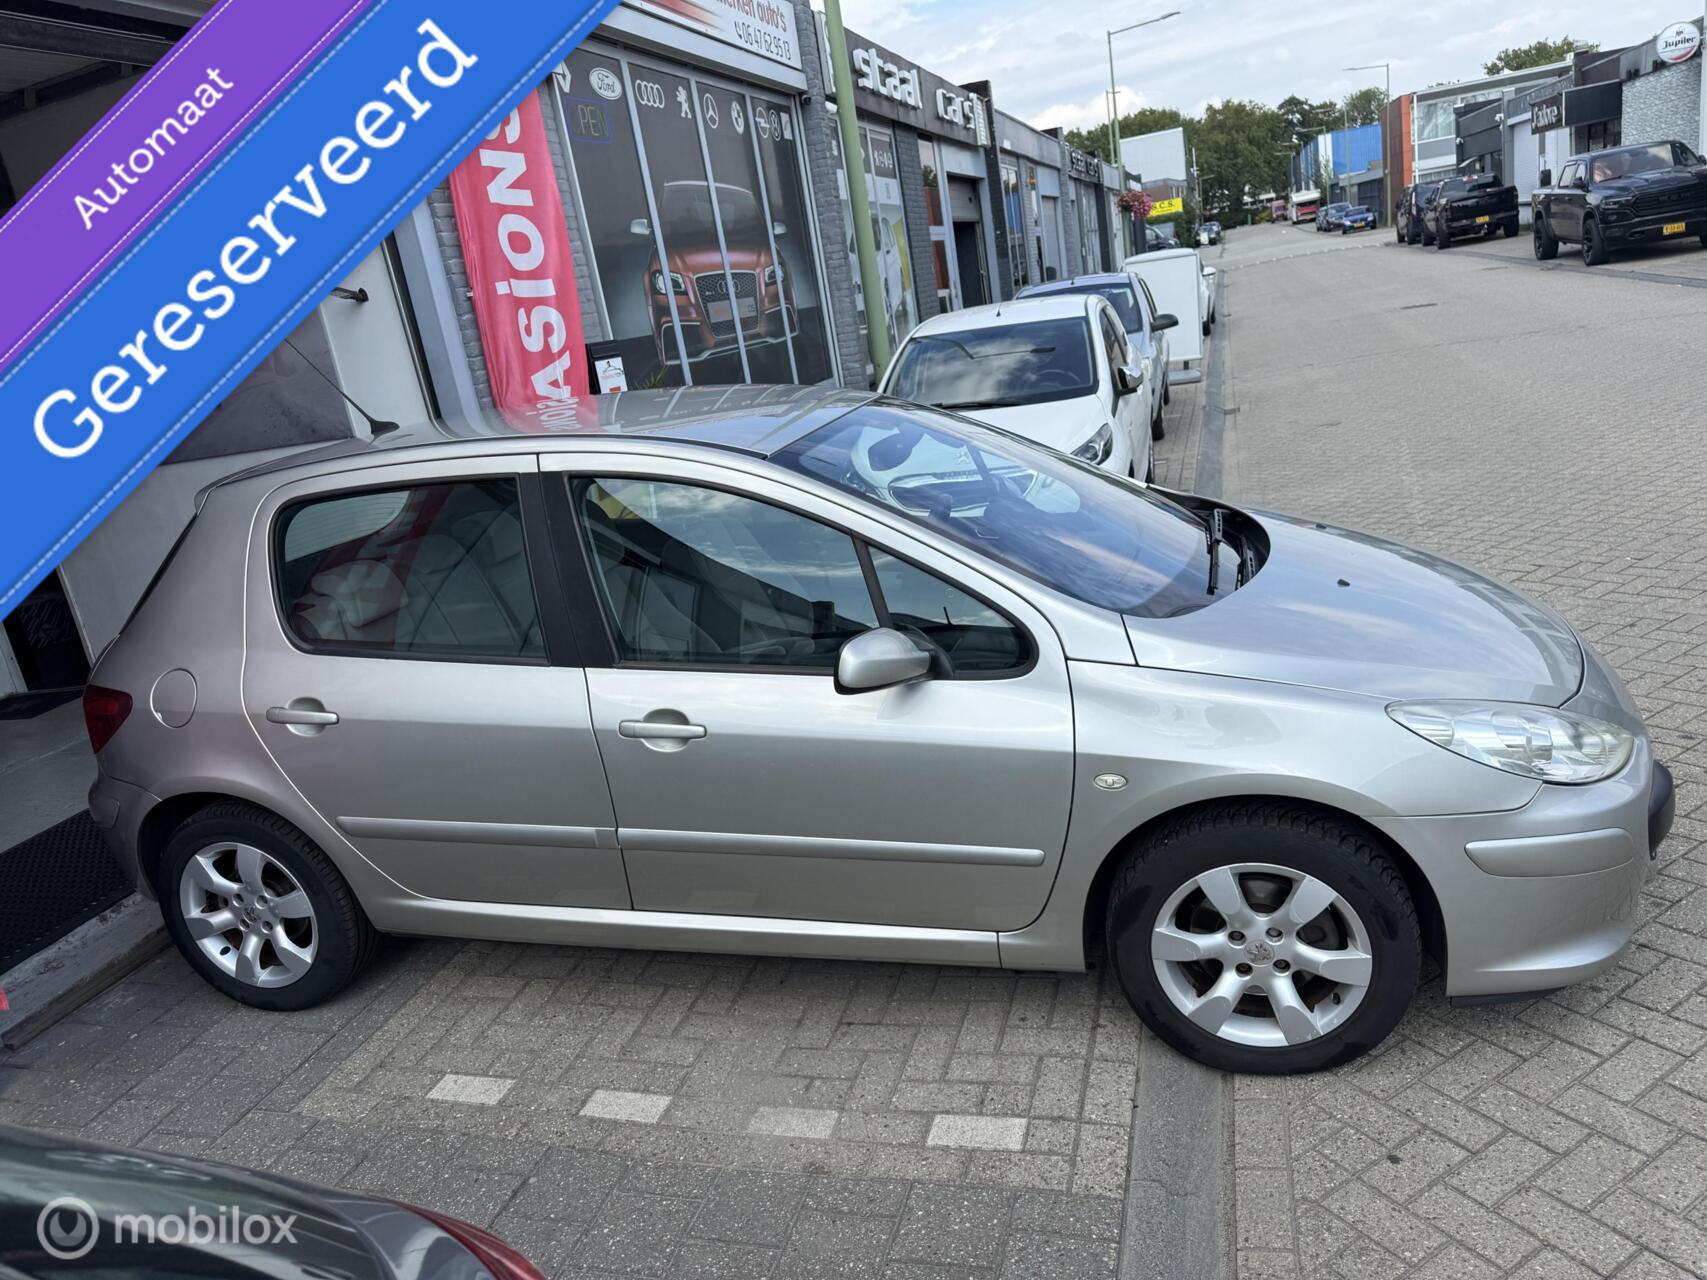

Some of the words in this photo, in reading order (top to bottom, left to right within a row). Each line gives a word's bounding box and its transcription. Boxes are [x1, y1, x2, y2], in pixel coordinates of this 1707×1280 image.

[1662, 36, 1697, 50] Jupiler
[596, 72, 616, 94] Ford
[852, 48, 923, 109] staal
